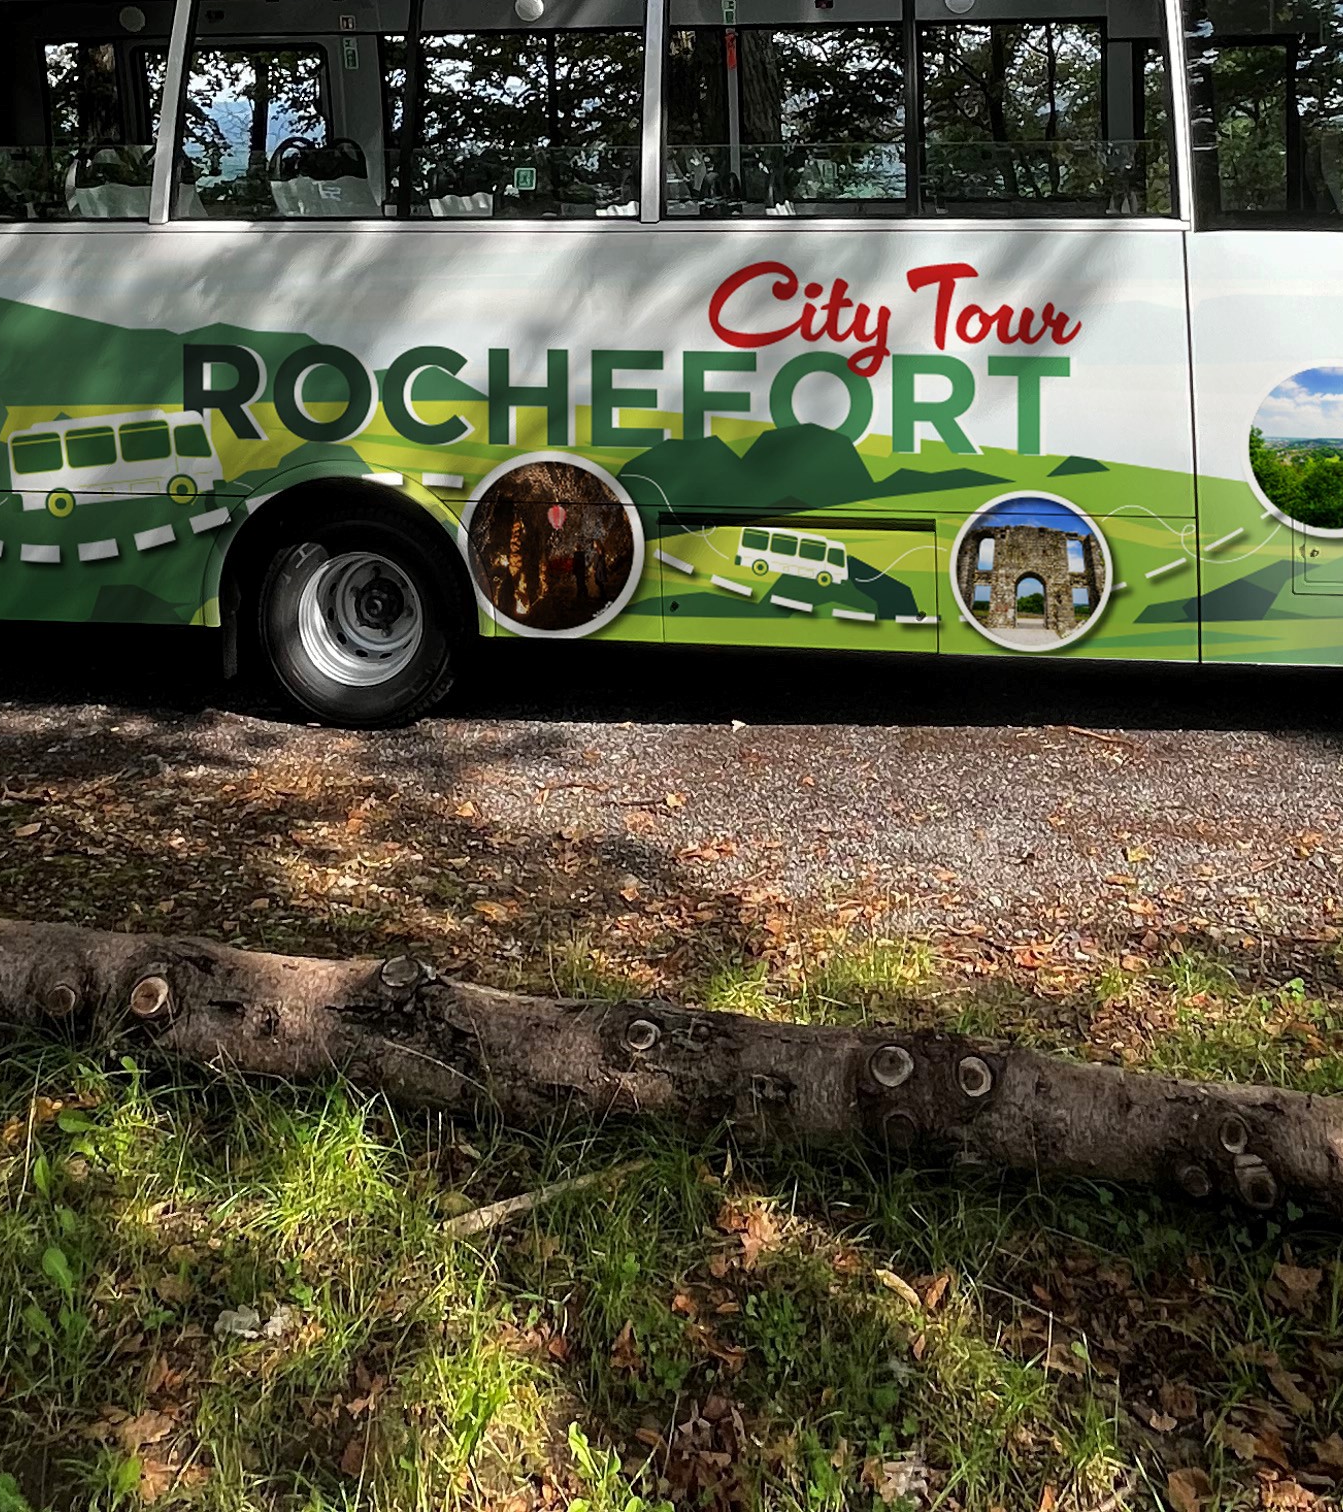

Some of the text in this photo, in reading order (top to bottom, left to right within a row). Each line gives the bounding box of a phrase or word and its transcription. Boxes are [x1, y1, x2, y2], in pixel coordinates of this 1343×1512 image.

[709, 262, 1081, 377] City Tour
[183, 343, 1072, 455] ROCHEFORT
